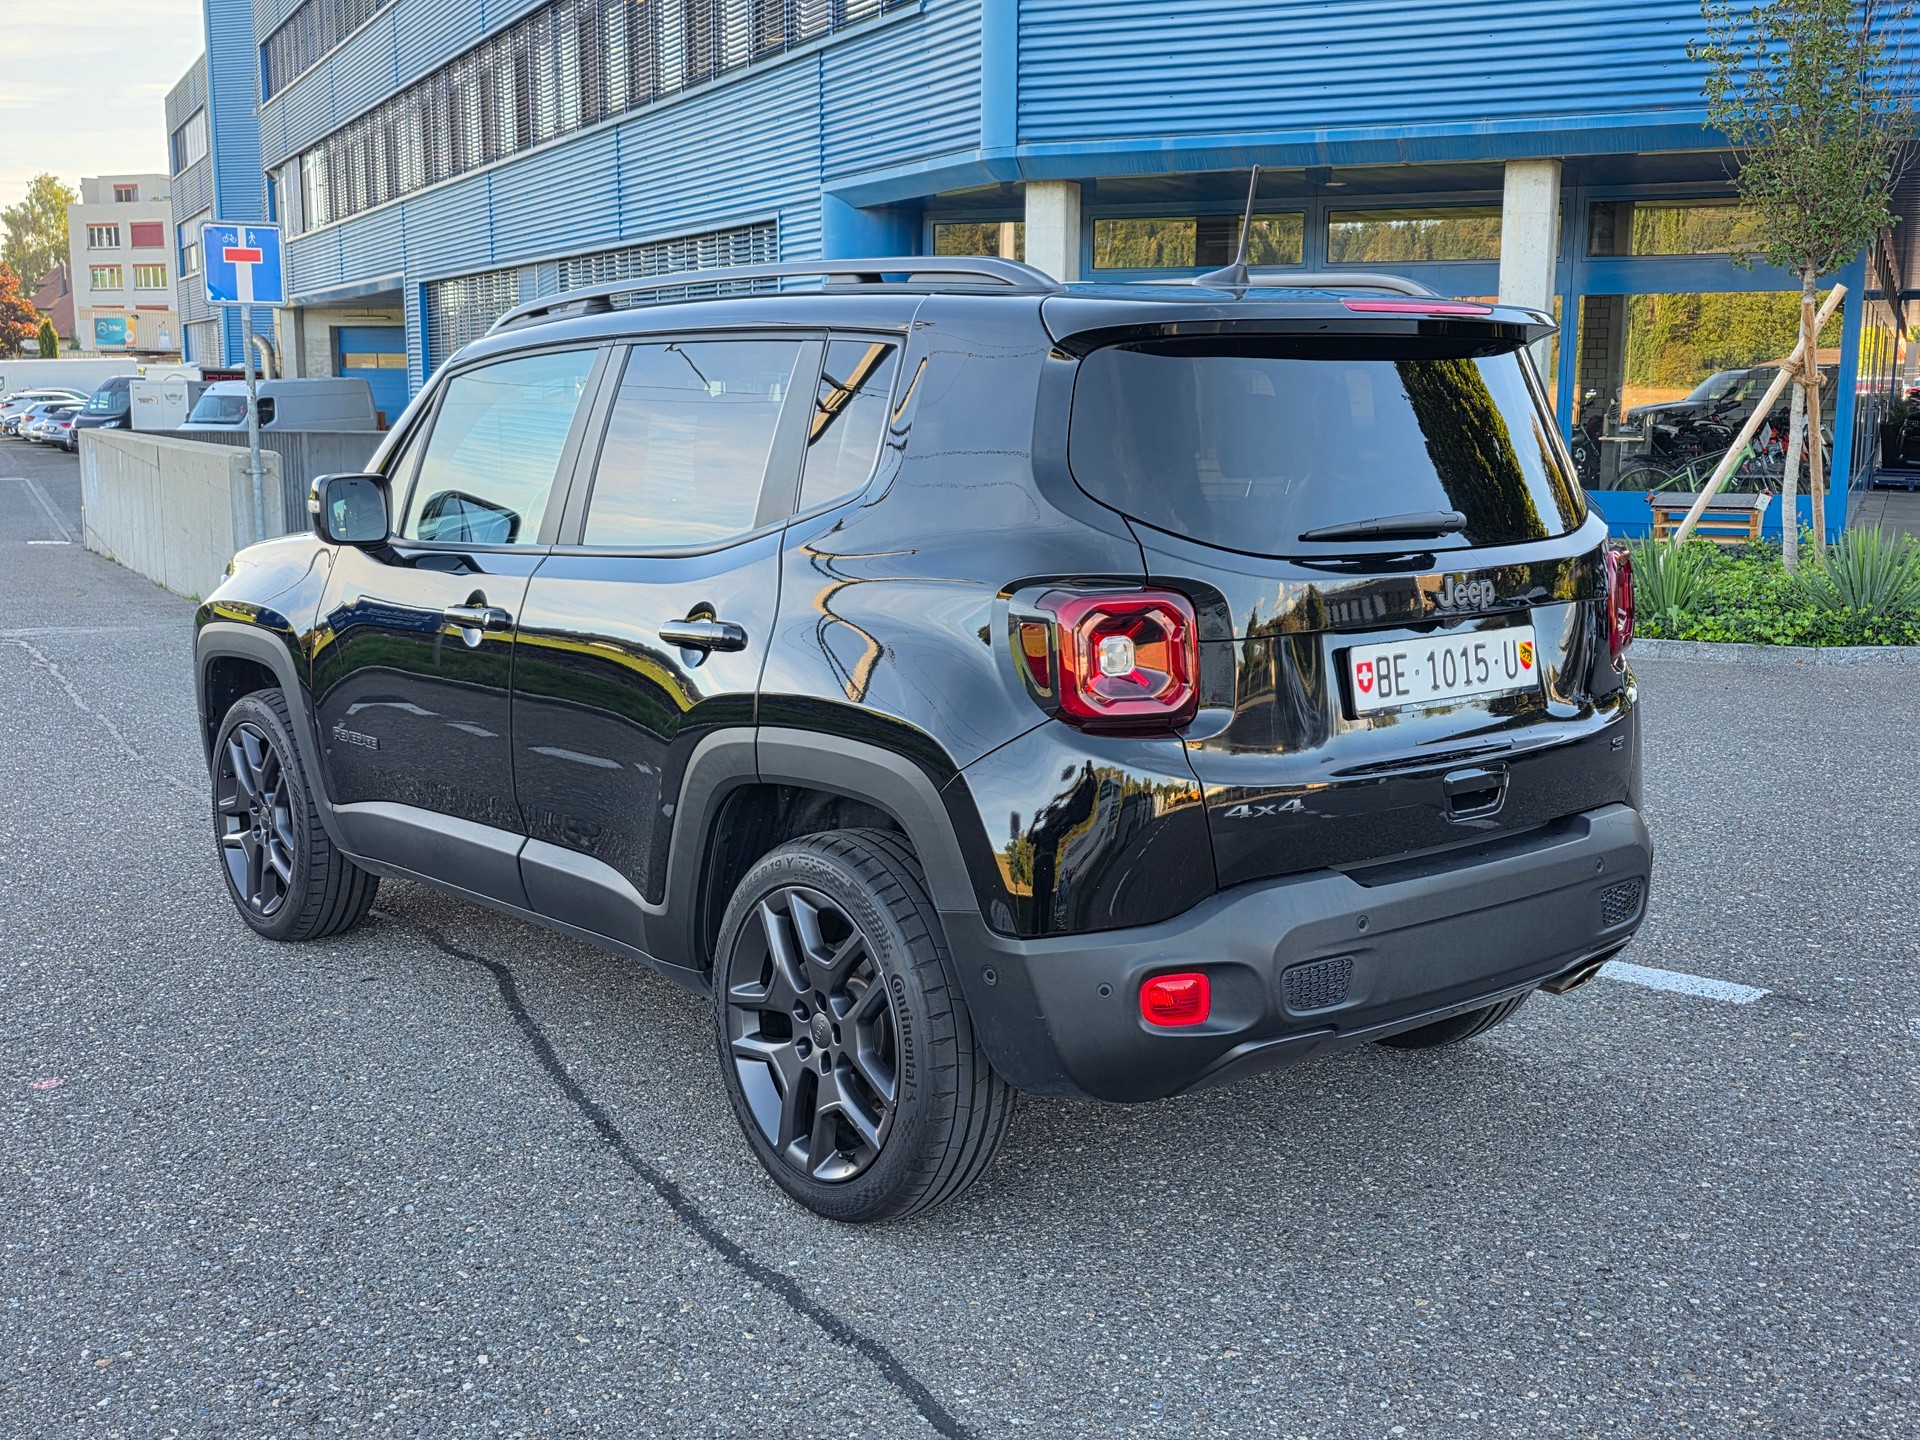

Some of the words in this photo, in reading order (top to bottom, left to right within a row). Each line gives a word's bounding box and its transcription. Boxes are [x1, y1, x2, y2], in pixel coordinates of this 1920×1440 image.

[1436, 575, 1496, 610] Jeep
[332, 726, 379, 750] RENEGADE
[1224, 799, 1305, 819] 4x4
[785, 857, 794, 868] Y
[890, 973, 918, 1089] Continental
